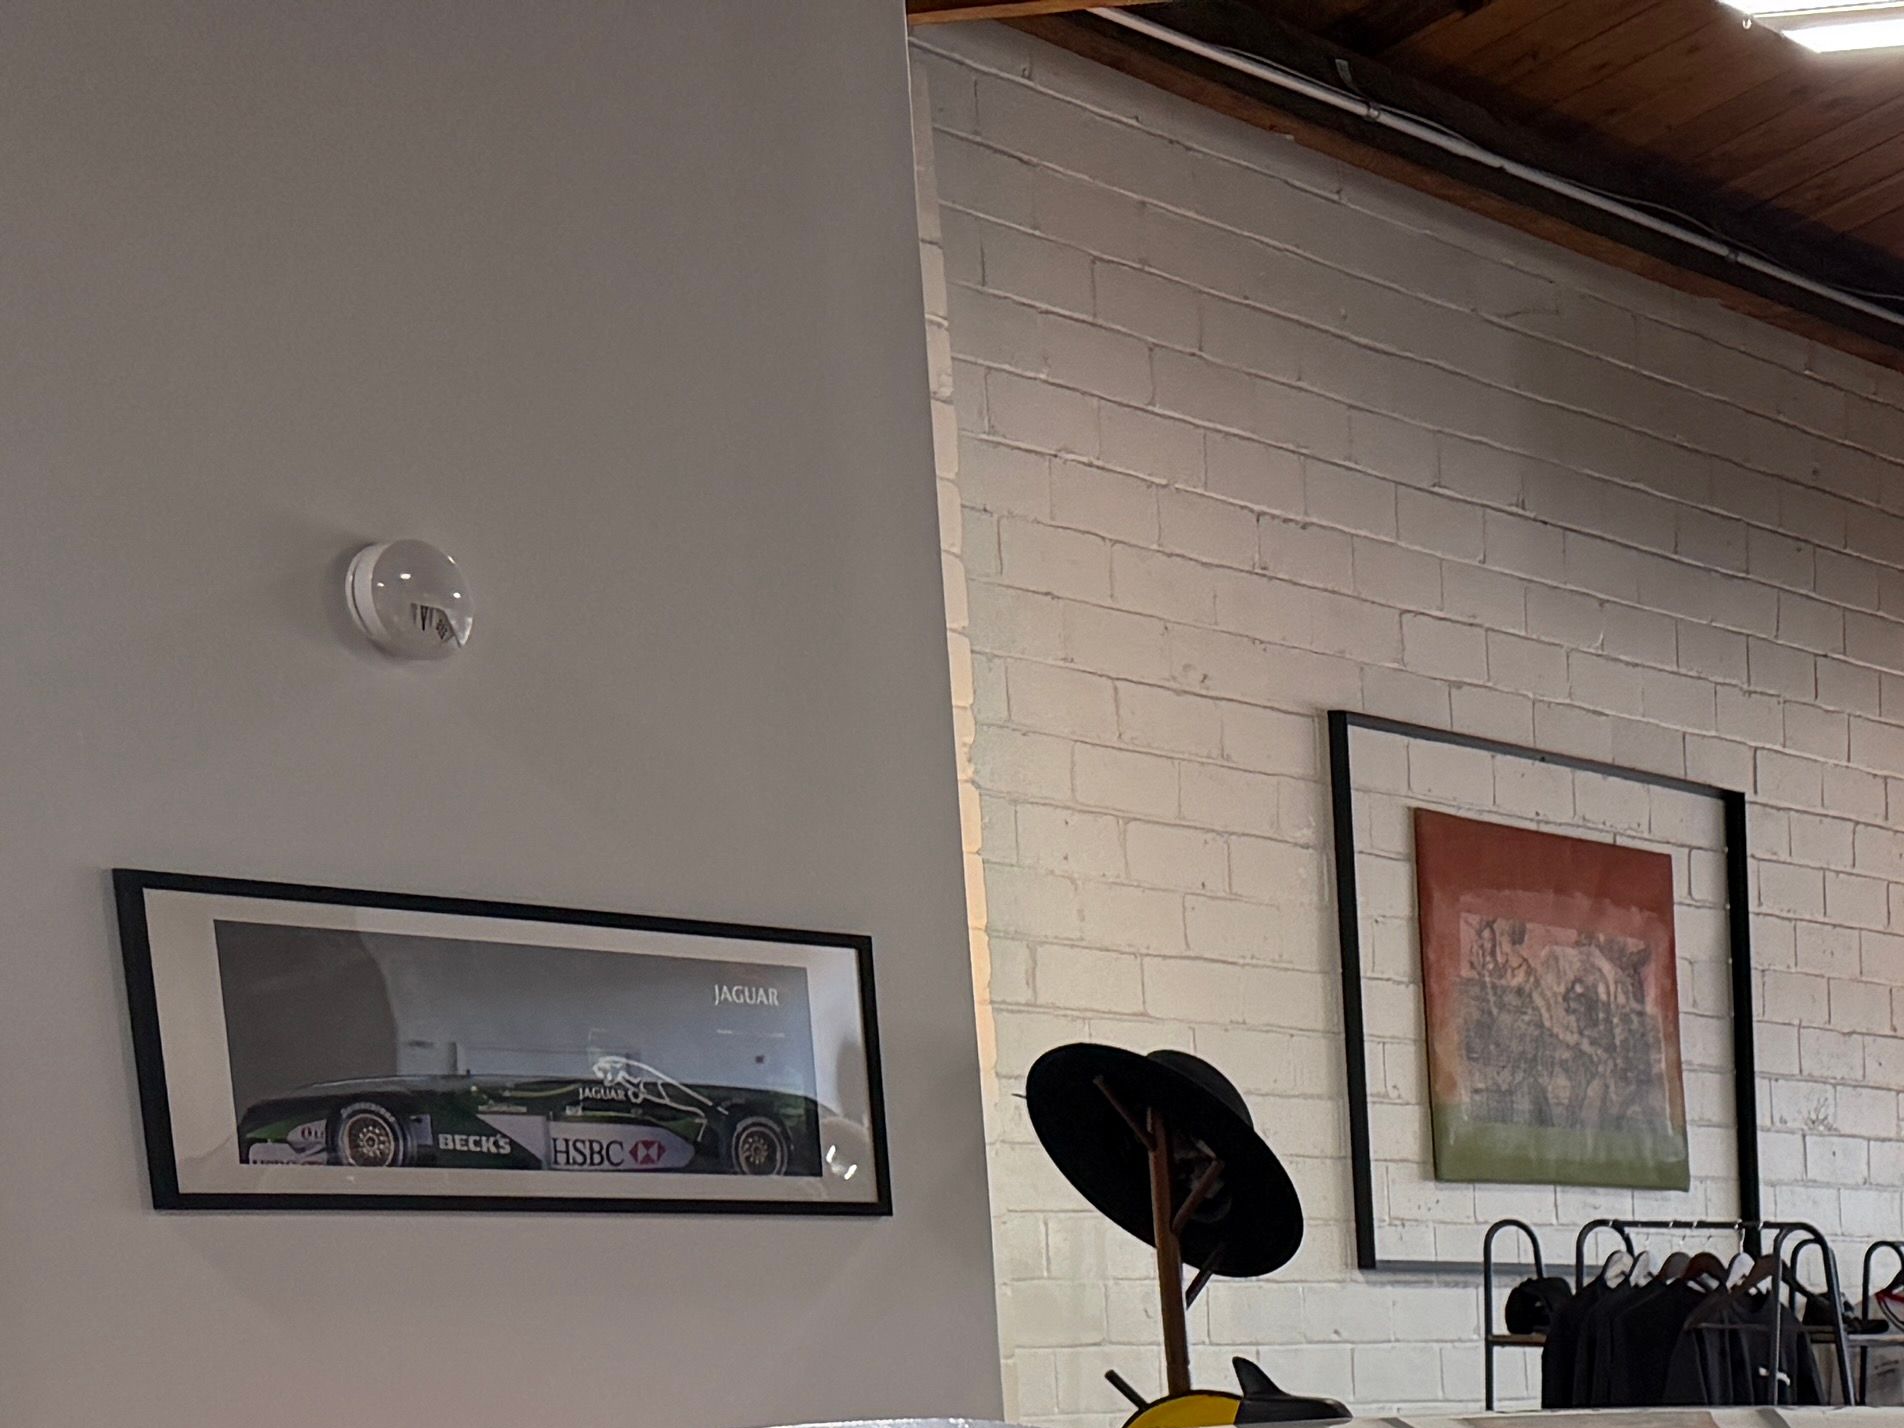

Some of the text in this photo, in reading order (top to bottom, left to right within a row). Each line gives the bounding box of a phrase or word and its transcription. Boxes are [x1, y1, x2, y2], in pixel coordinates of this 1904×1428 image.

[714, 984, 779, 1006] JAGUAR
[579, 1087, 628, 1101] JAGUAR
[438, 1133, 511, 1155] BECK'S
[552, 1137, 624, 1166] HSBC
